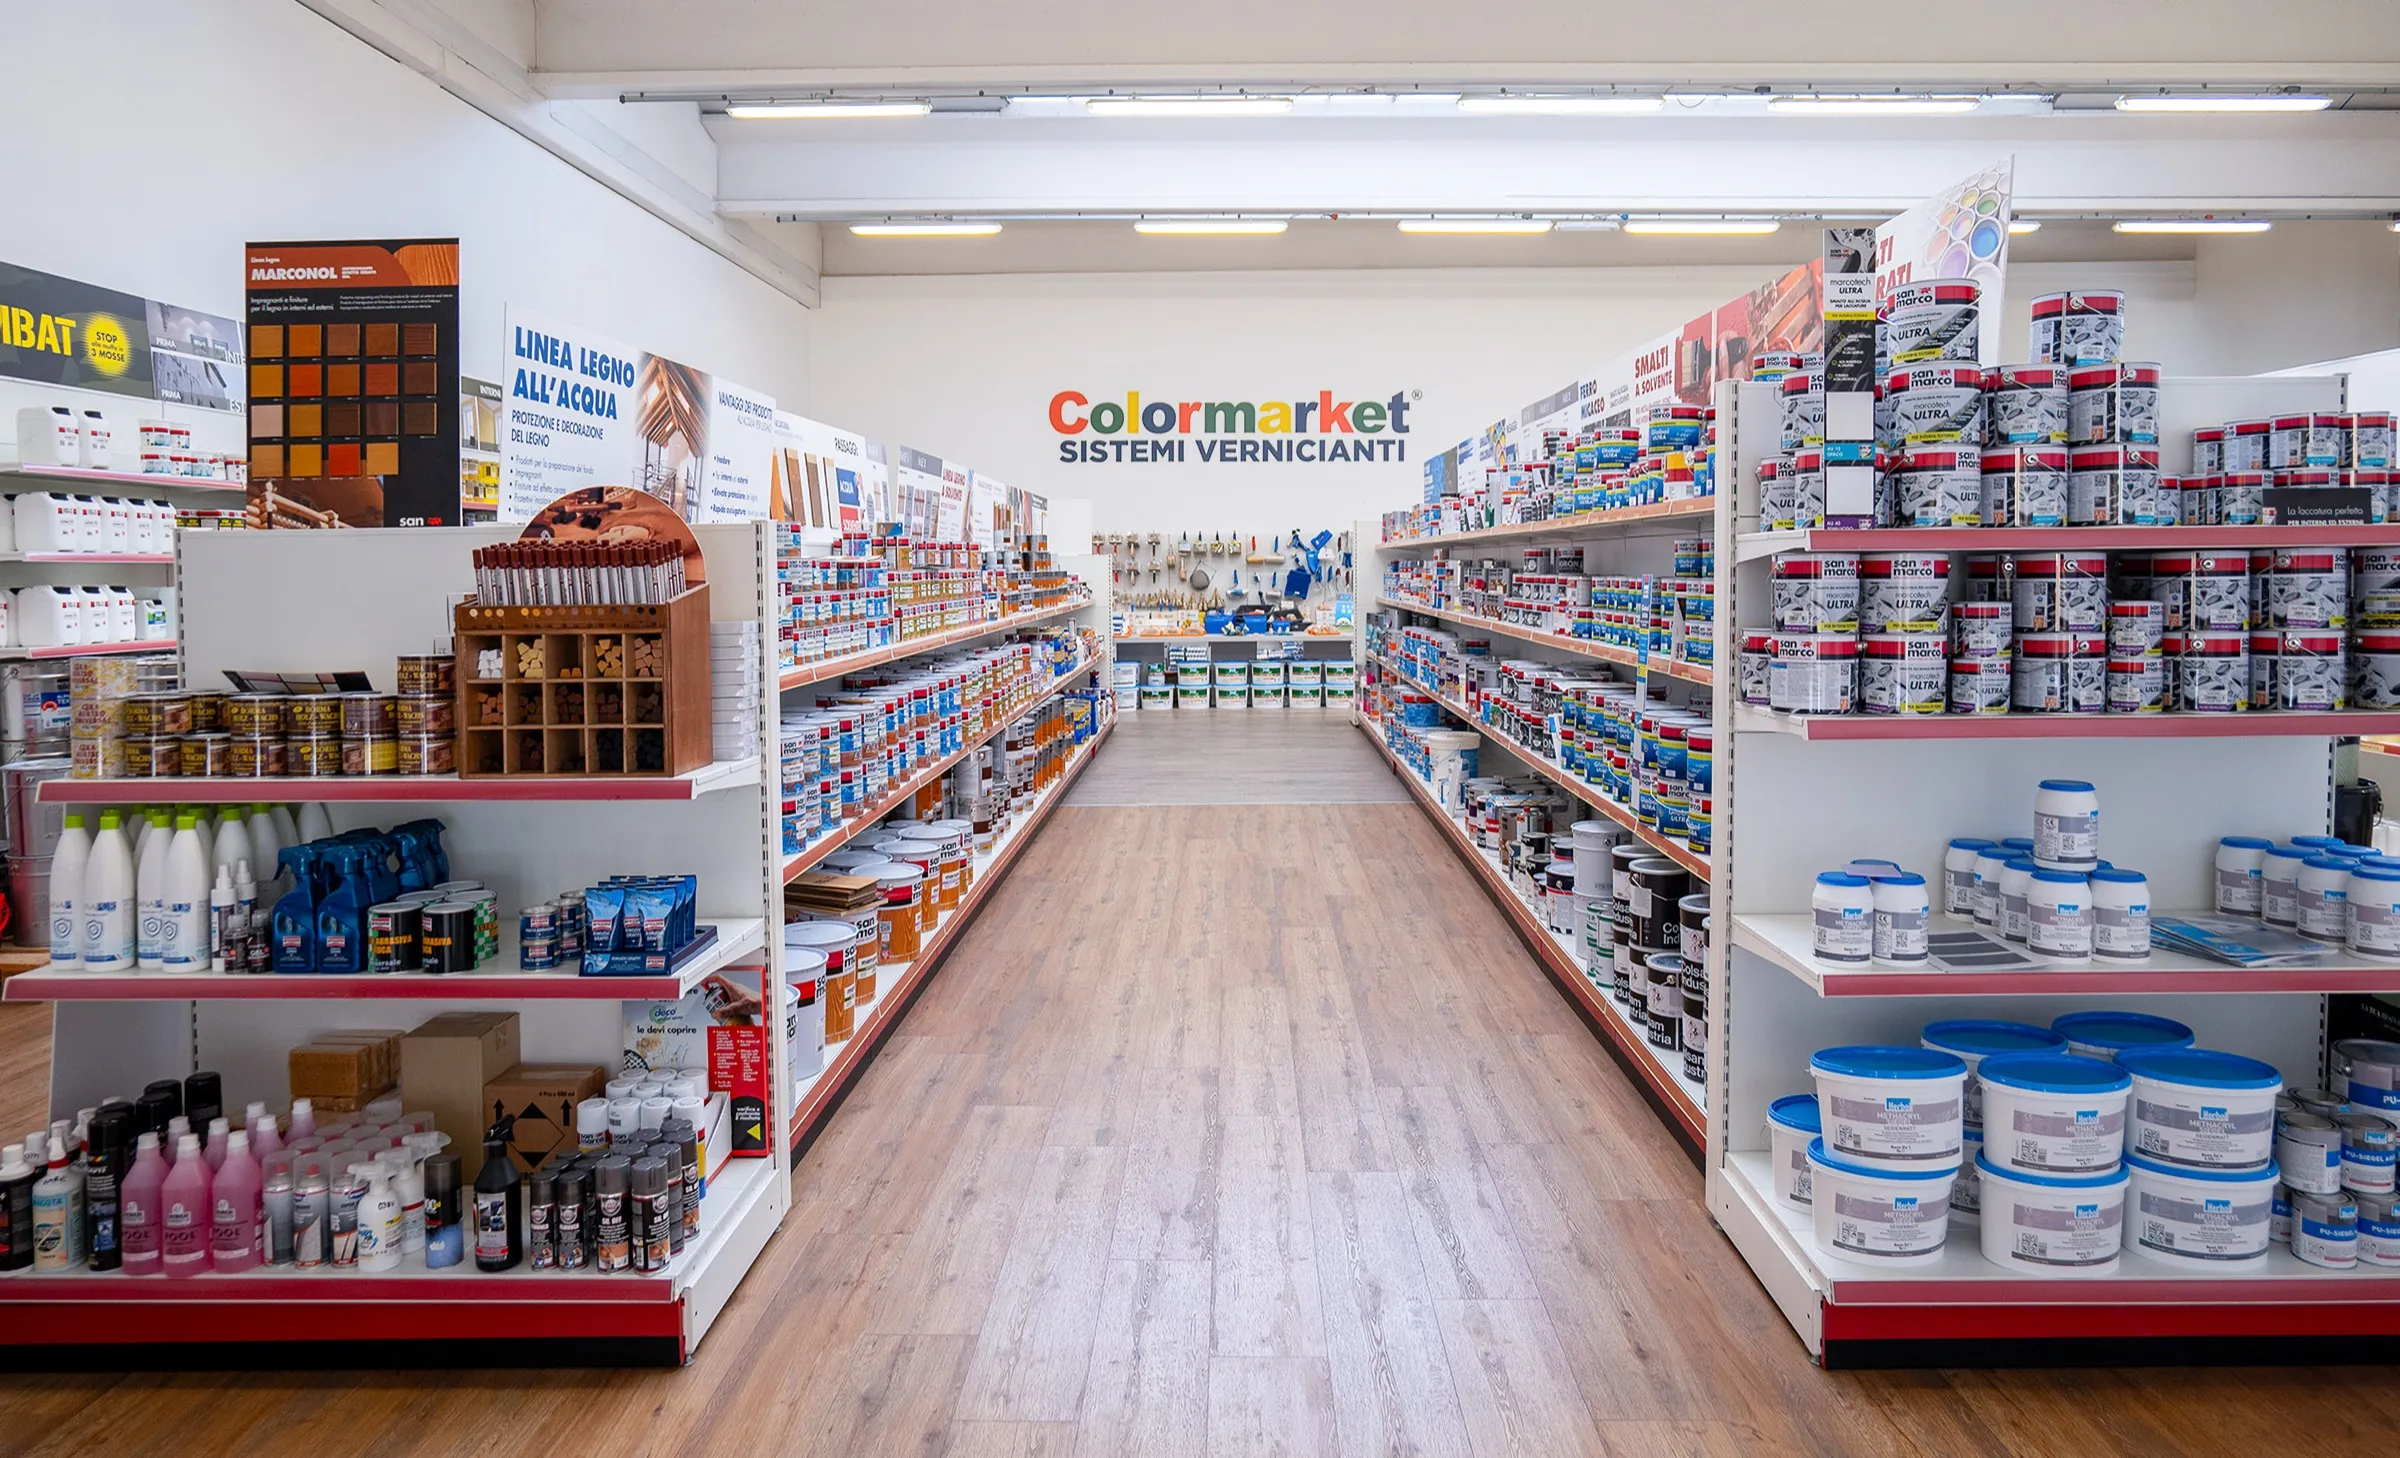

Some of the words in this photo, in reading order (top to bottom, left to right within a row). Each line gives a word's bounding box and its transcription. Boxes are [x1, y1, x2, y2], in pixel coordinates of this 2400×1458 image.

[251, 267, 338, 280] MARCONOL
[1830, 277, 1871, 286] marcotech
[289, 295, 309, 303] finiture
[1896, 289, 1914, 299] san
[1896, 295, 1933, 308] marco
[267, 305, 281, 313] legno
[96, 332, 118, 343] STOP
[1899, 327, 1931, 340] ULTRA
[156, 337, 177, 348] PRIMA
[99, 350, 125, 362] MOSSE
[515, 326, 572, 371] LINEA
[580, 347, 635, 388] LEGNO
[1635, 345, 1669, 379] SMALTI
[1912, 369, 1933, 378] san
[1635, 384, 1640, 397] A
[1642, 370, 1673, 394] SOLVENTE
[1912, 376, 1952, 386] marco
[161, 389, 181, 400] PRIMA
[513, 368, 617, 419] ALL'ACQUA
[1580, 379, 1598, 400] FERRO
[1049, 390, 1410, 435] Colormarket
[1581, 396, 1605, 420] MICACEO
[1914, 410, 1950, 419] ULTRA
[512, 410, 555, 431] PROTEZIONE
[562, 420, 603, 440] DECORAZIONE
[511, 428, 524, 442] DEL
[525, 432, 550, 447] LEGNO
[1059, 440, 1185, 463] SISTEMI
[1197, 439, 1404, 463] VERNICIANTI
[1958, 451, 1975, 459] san
[2298, 506, 2333, 515] laccatura
[2334, 505, 2363, 516] perfetta
[400, 517, 424, 526] san
[1825, 560, 1844, 568] san
[1893, 560, 1915, 568] san
[1824, 567, 1856, 576] marco
[1893, 567, 1932, 576] marco
[1896, 600, 1929, 609] ULTRA
[1780, 640, 1797, 648] san
[1908, 641, 1928, 649] san
[1779, 648, 1814, 657] marco
[1908, 649, 1941, 657] marco
[402, 663, 423, 671] BORMA
[1909, 681, 1939, 690] ULTRA
[240, 706, 265, 714] BORMA
[941, 842, 957, 850] san
[856, 917, 875, 928] san
[647, 1025, 665, 1033] devi
[667, 1026, 697, 1035] coprire
